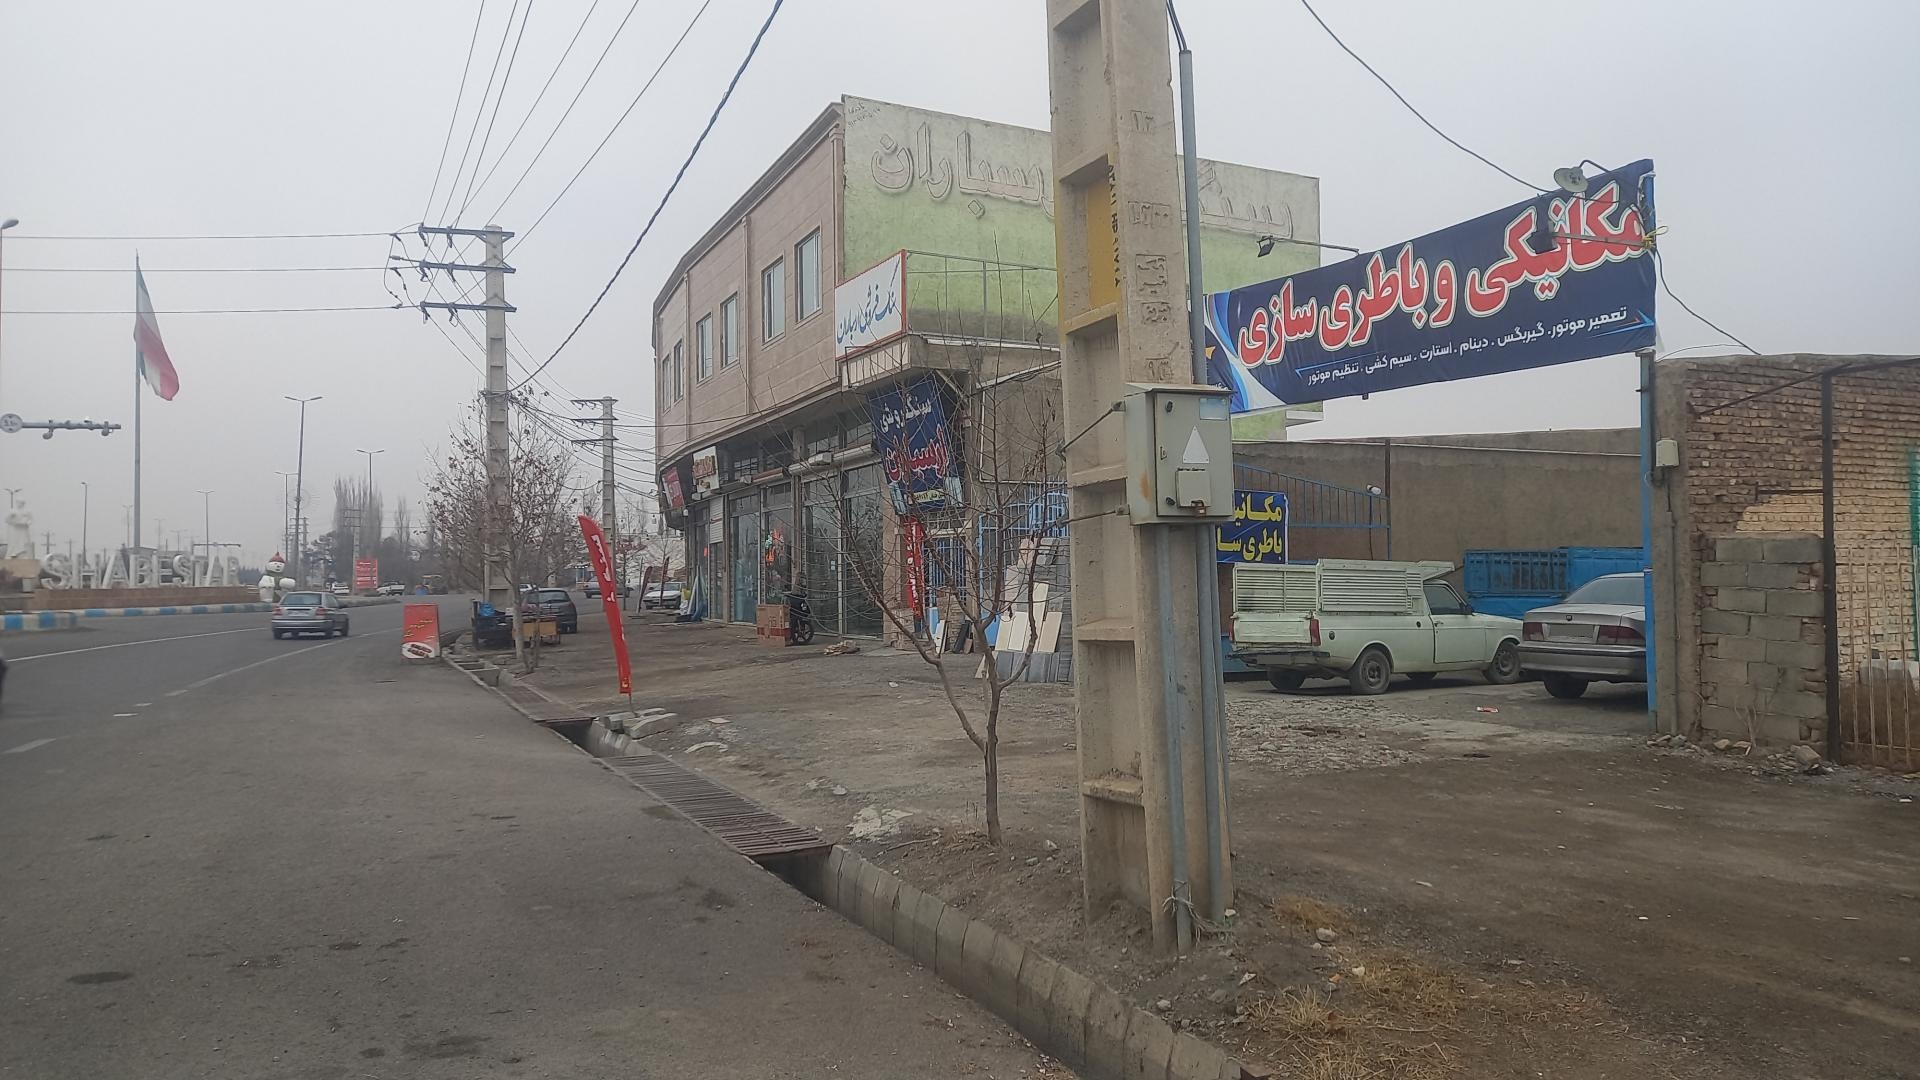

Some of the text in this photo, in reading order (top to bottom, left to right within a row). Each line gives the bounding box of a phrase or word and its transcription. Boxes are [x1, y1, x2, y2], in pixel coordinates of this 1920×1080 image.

[1237, 180, 1650, 369] مکانیکی و باطری سازی
[1587, 306, 1628, 331] تعمیر
[1419, 341, 1453, 362] استارت
[1459, 337, 1489, 356] دینام
[1332, 361, 1359, 382] تنظیم
[1364, 354, 1388, 374] کشی
[1389, 353, 1412, 370] سیم
[1307, 370, 1331, 386] موتور
[1242, 527, 1283, 562] باطری
[39, 552, 240, 590] SHABESTAR
